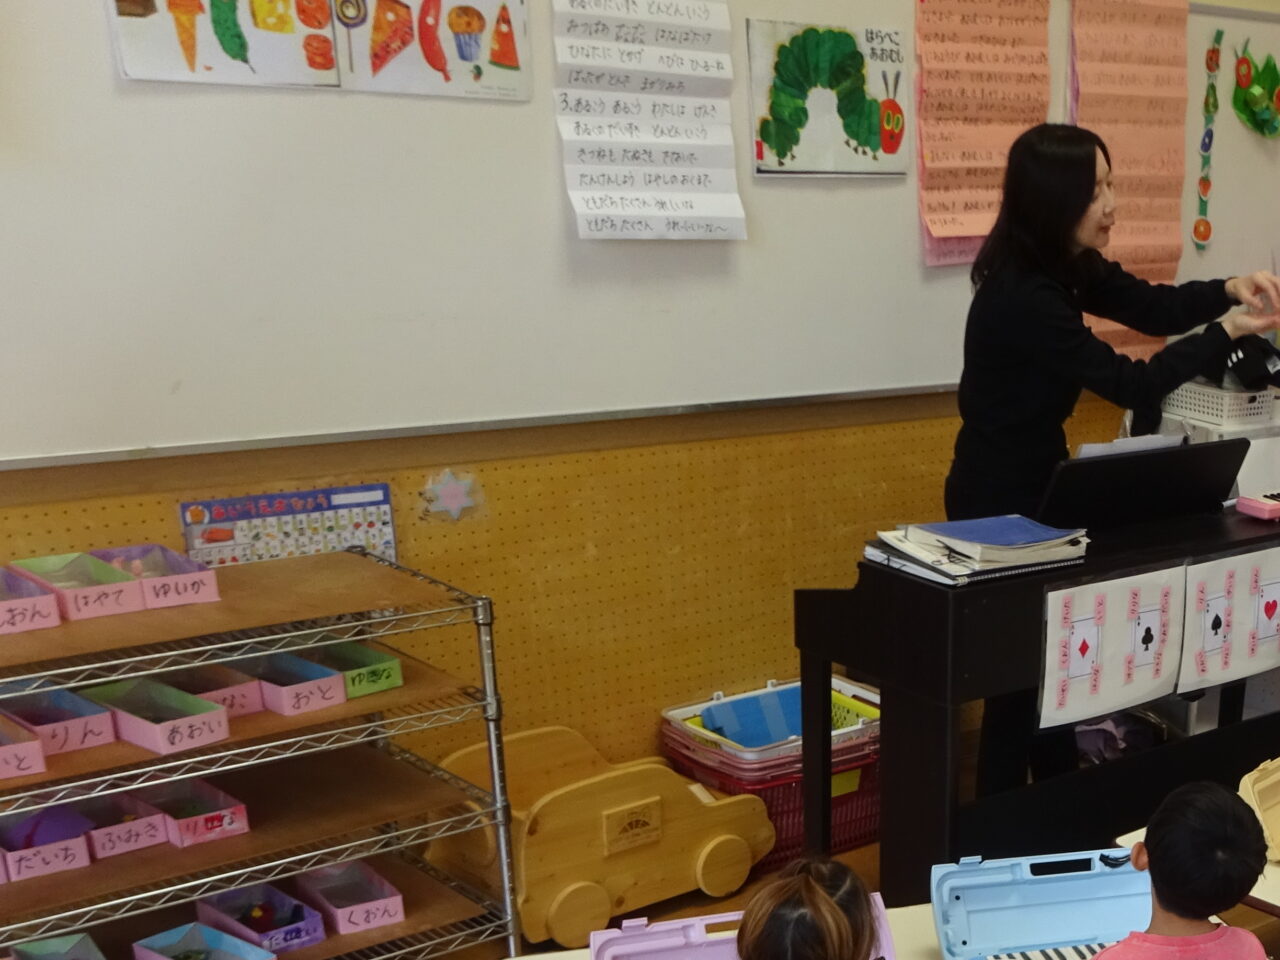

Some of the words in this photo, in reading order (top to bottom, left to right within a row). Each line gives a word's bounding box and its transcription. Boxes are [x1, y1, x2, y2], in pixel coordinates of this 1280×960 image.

[865, 28, 900, 46] はらぺこ
[869, 46, 905, 64] あおむし
[73, 588, 125, 612] はやて
[152, 578, 207, 599] ゆいか
[0, 603, 50, 628] おん
[291, 684, 335, 710] おと
[51, 721, 103, 750] りん
[167, 720, 223, 747] あおい
[101, 822, 160, 852] ふみき
[14, 846, 77, 876] だいち
[347, 907, 399, 927] くおん
